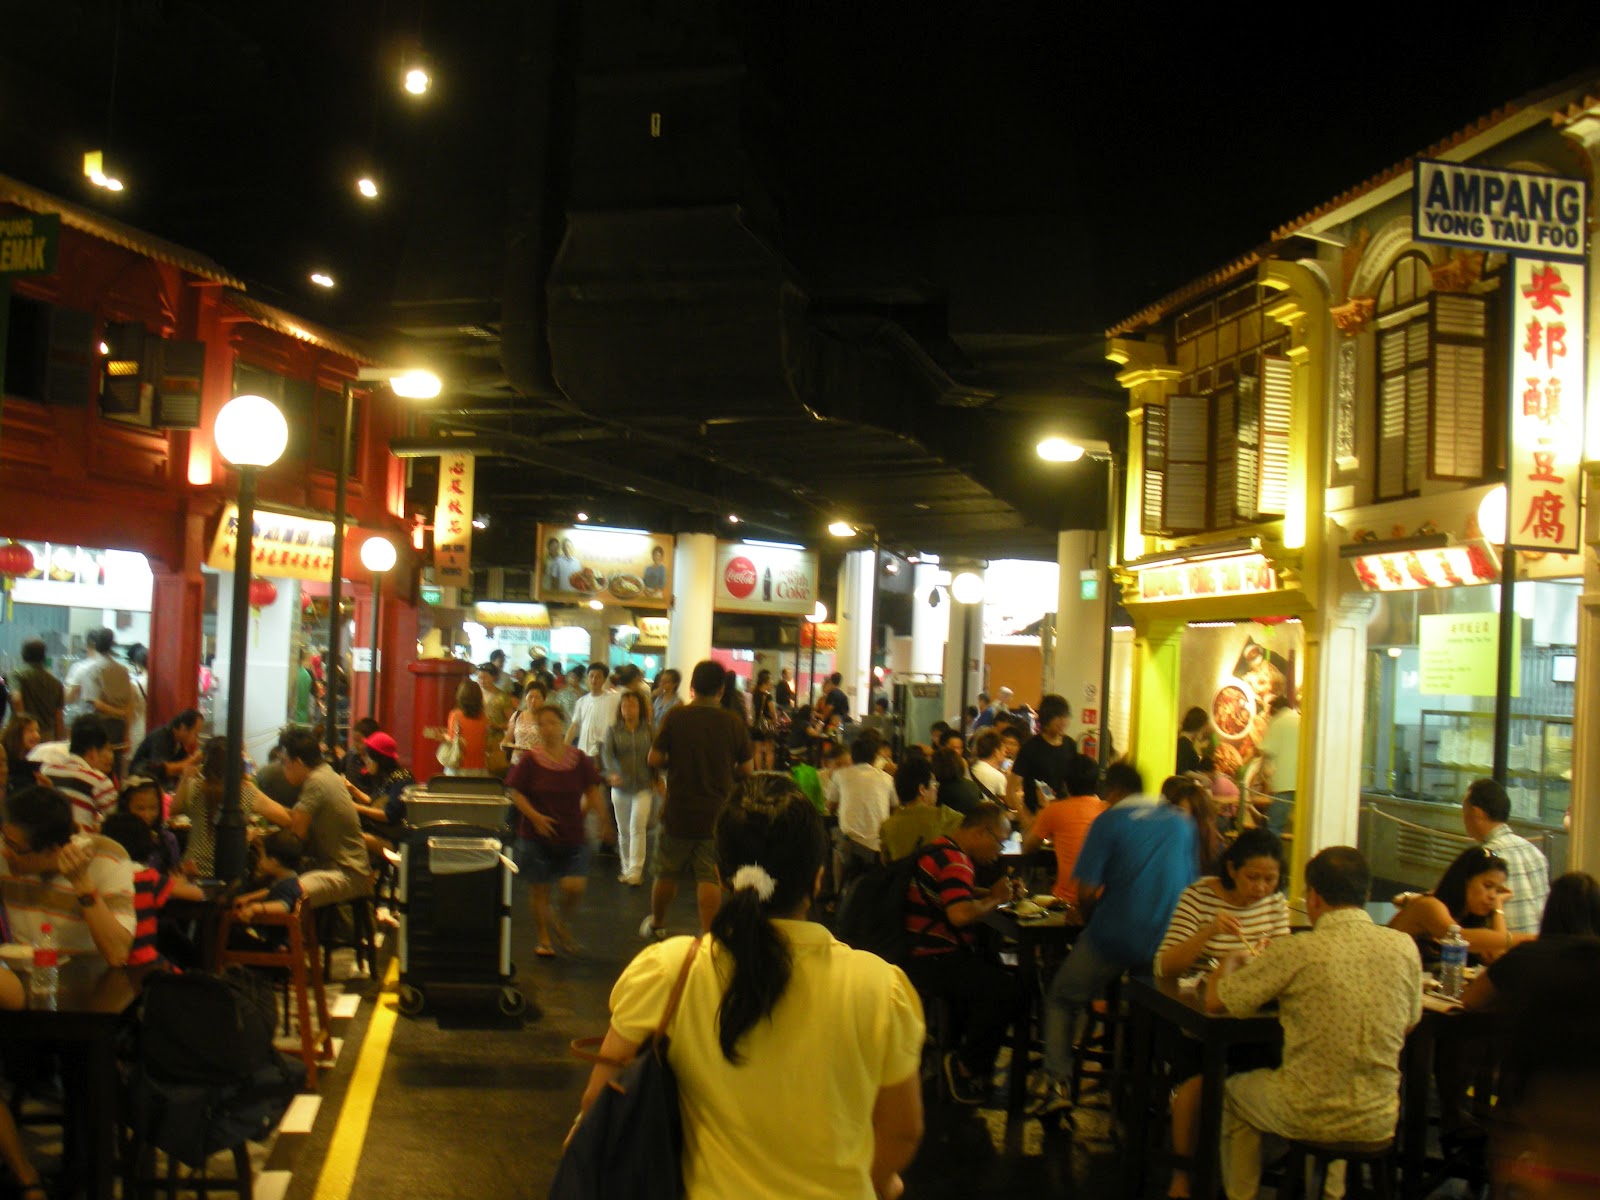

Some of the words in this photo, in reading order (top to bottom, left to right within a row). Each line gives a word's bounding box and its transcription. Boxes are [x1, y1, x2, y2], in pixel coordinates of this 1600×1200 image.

[1425, 170, 1580, 226] AMPANG
[1425, 211, 1485, 238] YONG
[1490, 219, 1531, 244] TAU
[1536, 224, 1579, 249] FOO
